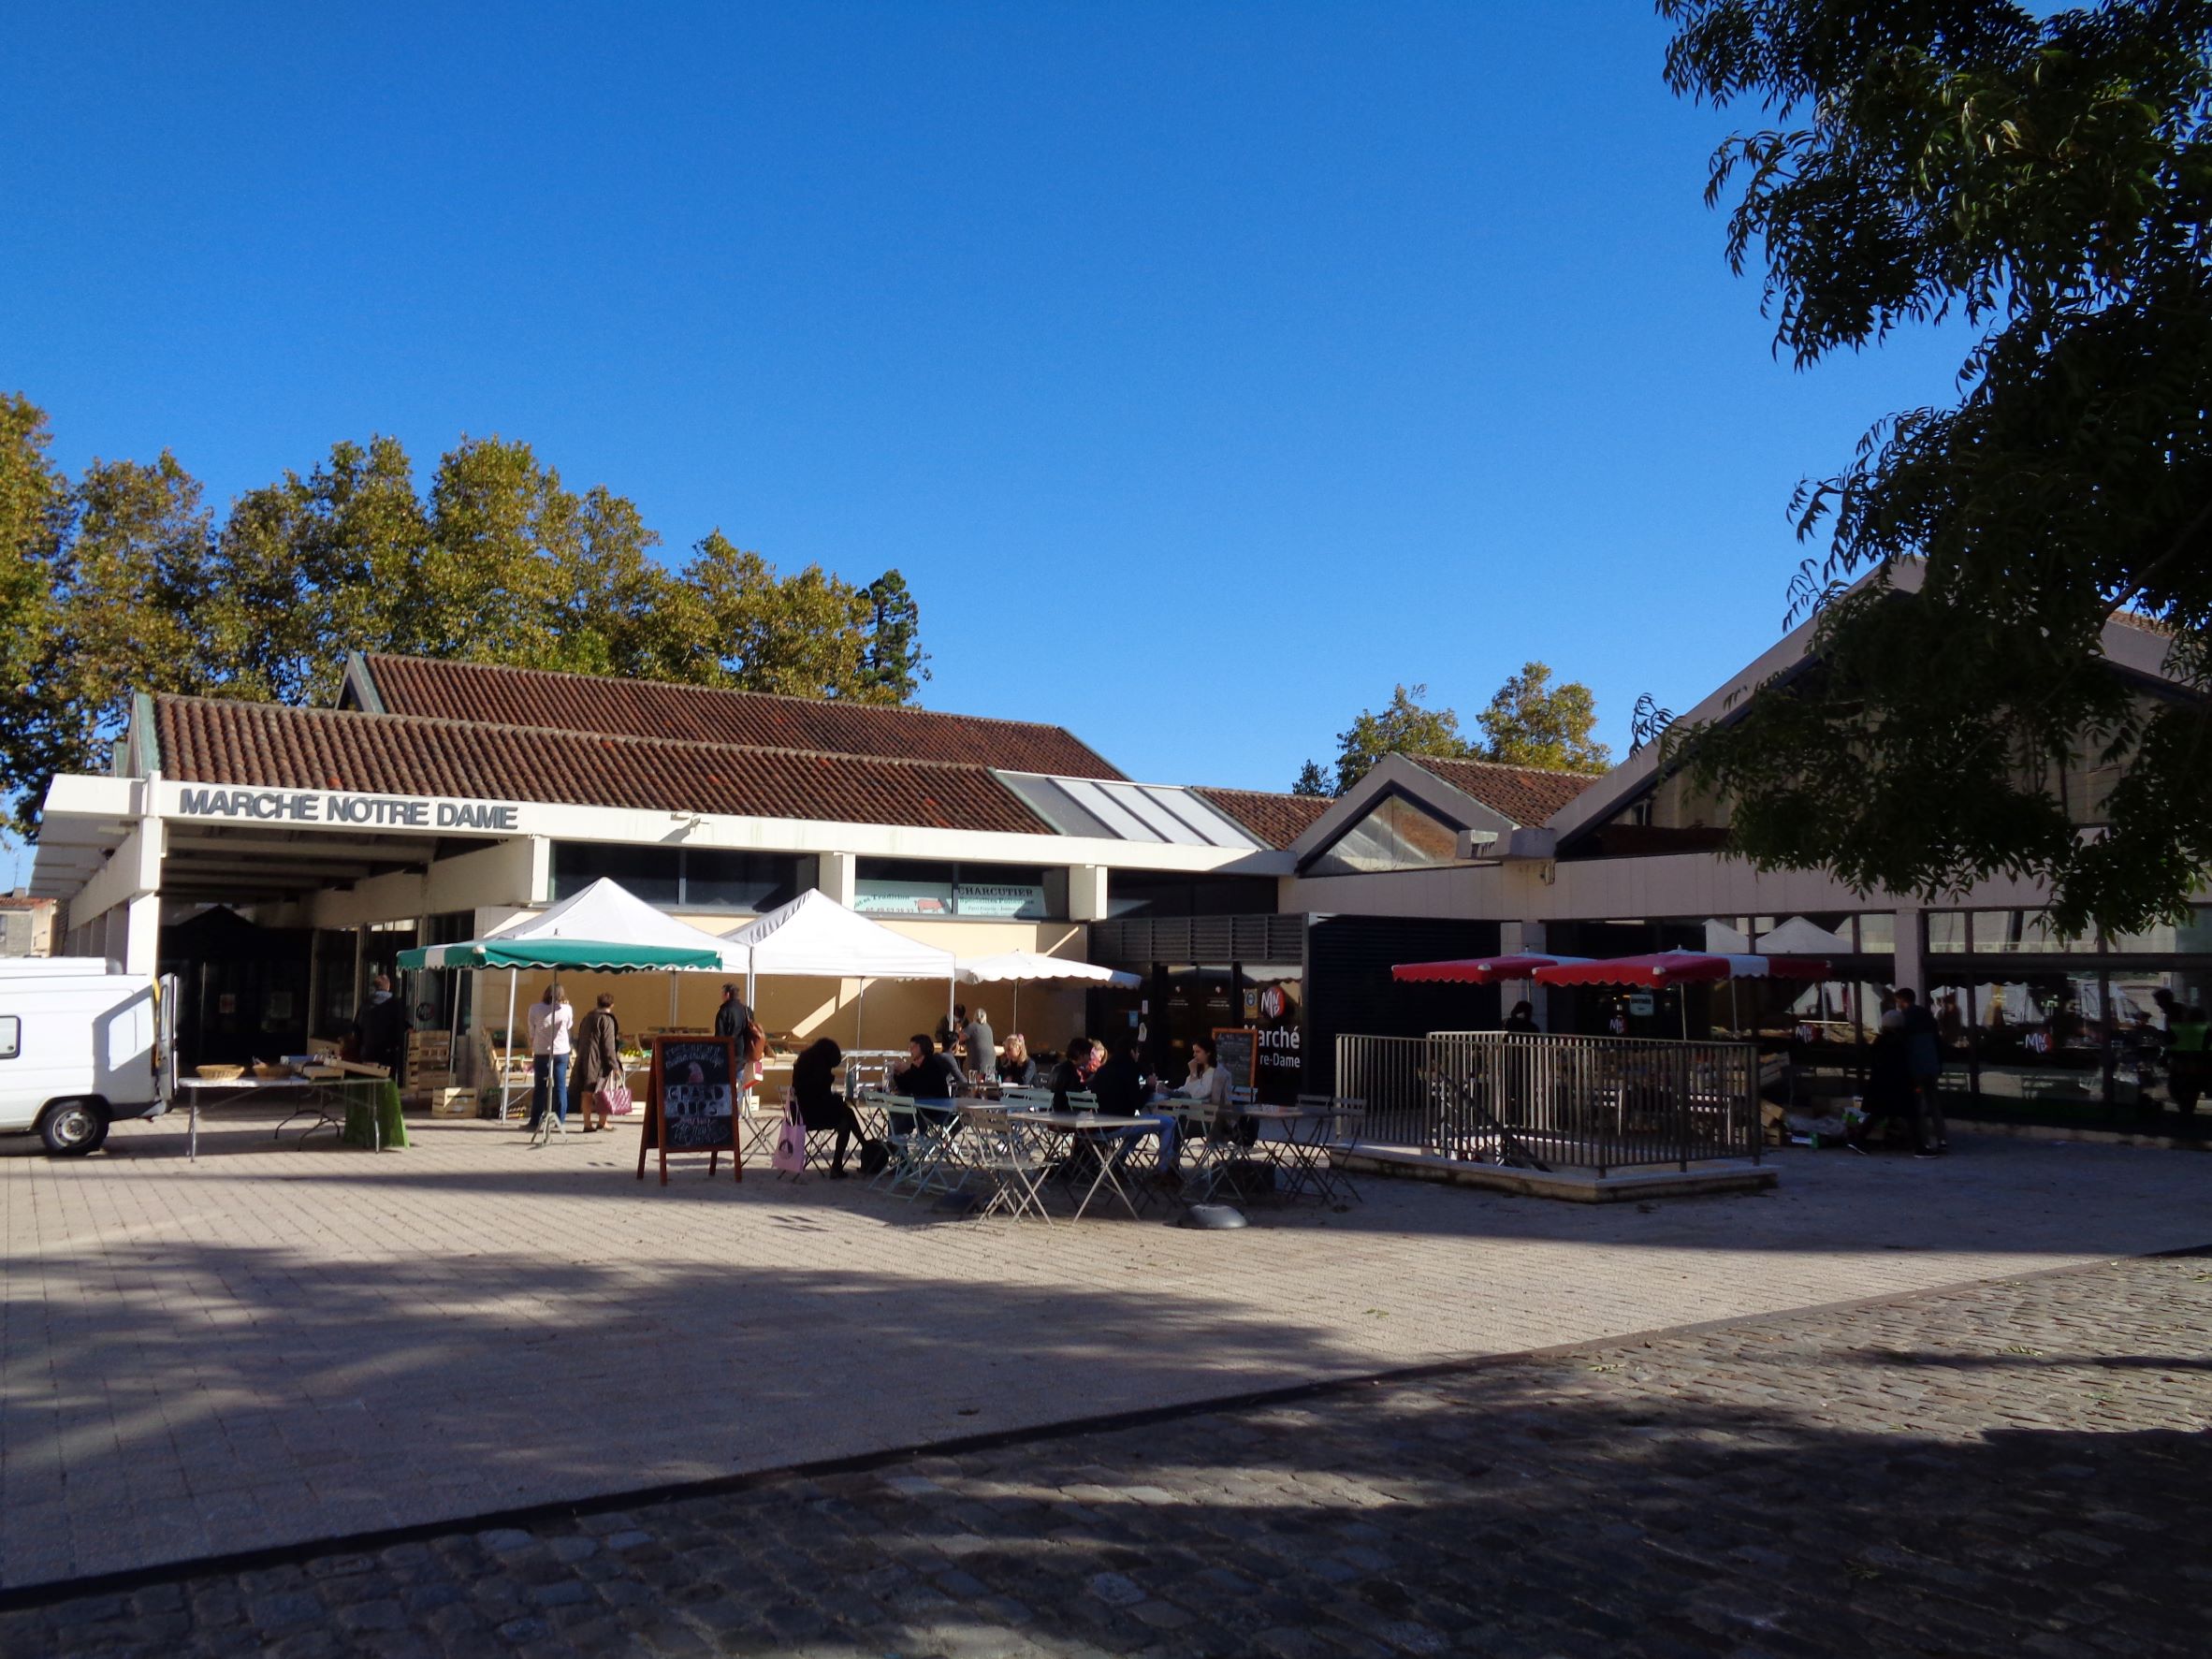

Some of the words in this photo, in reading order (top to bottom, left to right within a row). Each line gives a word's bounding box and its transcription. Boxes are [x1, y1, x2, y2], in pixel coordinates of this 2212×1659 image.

[179, 788, 320, 822] MARCHE
[327, 795, 429, 826] NOTRE
[436, 802, 518, 830] DAME
[957, 885, 1033, 897] CHARCUTIER
[1259, 1054, 1301, 1068] re-Dame
